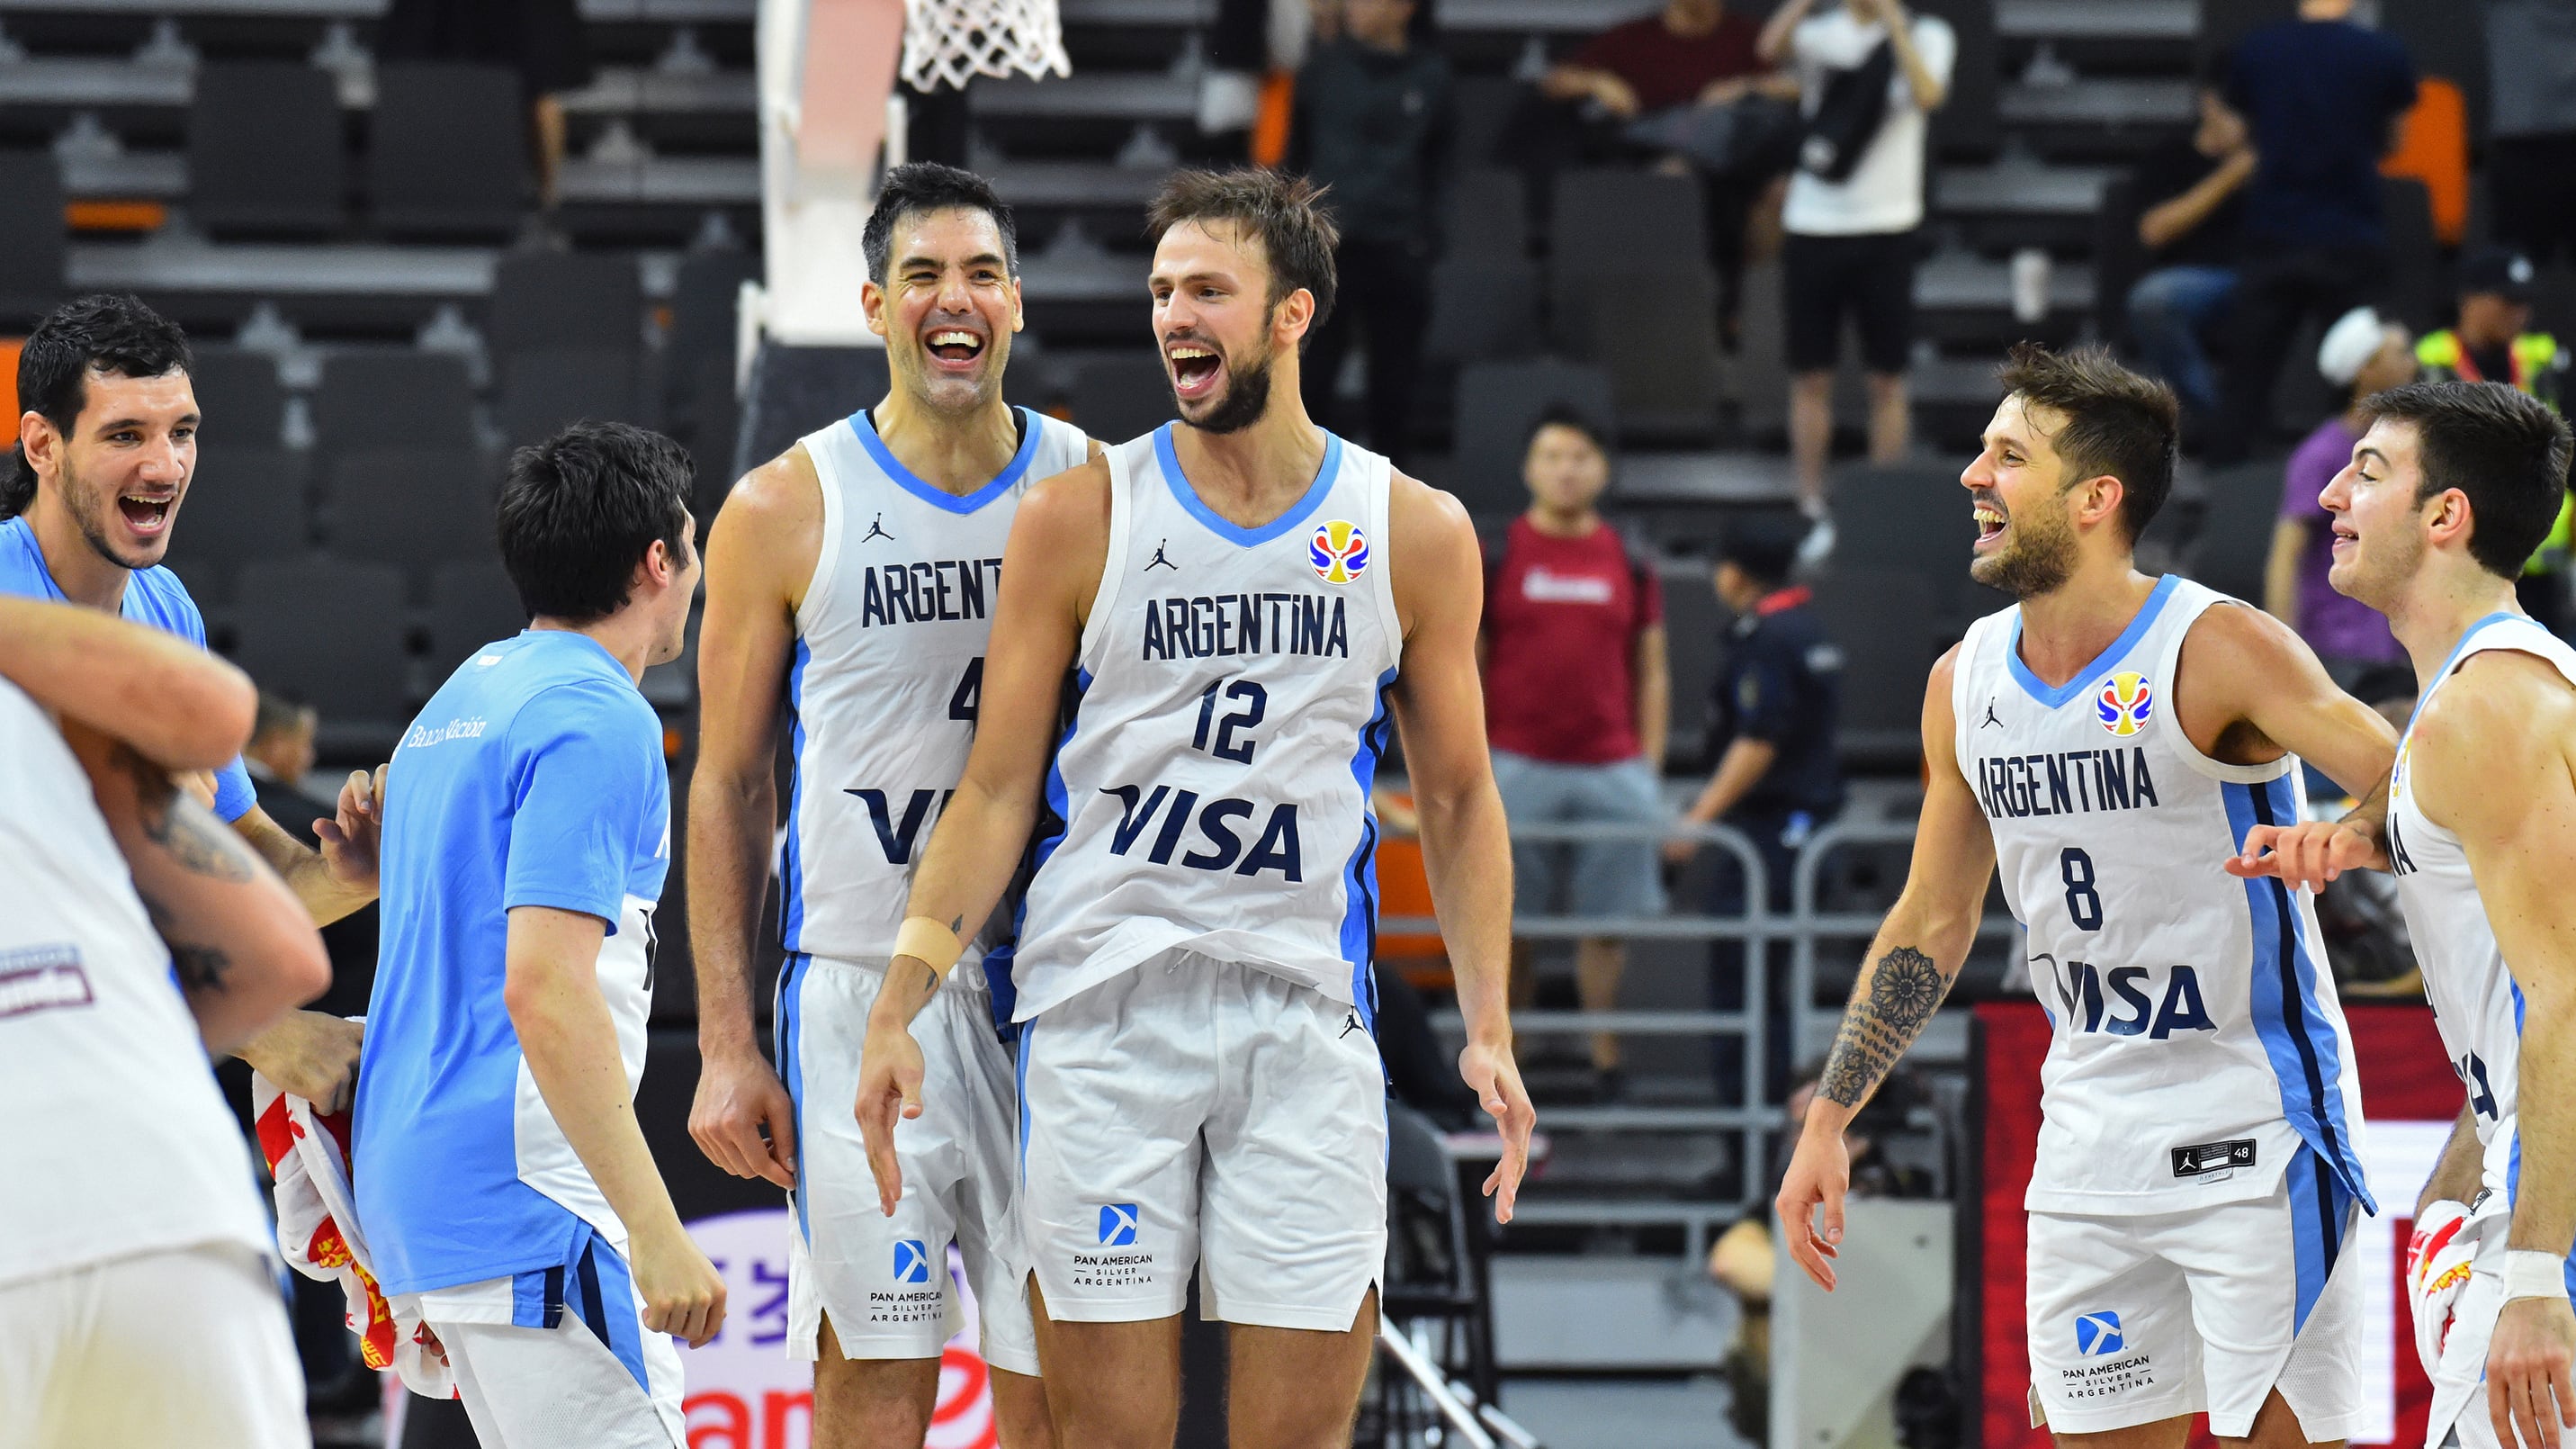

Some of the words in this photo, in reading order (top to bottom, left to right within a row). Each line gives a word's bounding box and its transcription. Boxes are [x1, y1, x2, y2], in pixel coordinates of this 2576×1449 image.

[862, 557, 1003, 628] ARGENT
[1143, 592, 1349, 661] ARGENTINA
[948, 656, 985, 739] 4
[1191, 679, 1268, 765] 12
[1979, 746, 2159, 818] ARGENTINA
[1099, 784, 1303, 883] VISA
[2060, 847, 2104, 932] 8
[2028, 952, 2219, 1040] VISA
[2233, 1146, 2250, 1159] 48
[1073, 1255, 1098, 1266] PAN
[1100, 1254, 1153, 1266] AMERICAN
[1095, 1267, 1137, 1276] SILVER
[1073, 1275, 1153, 1287] ARGENTINA
[869, 1292, 894, 1302] PAN
[891, 1303, 933, 1312] SILVER
[2062, 1368, 2086, 1380] PAN
[2087, 1354, 2150, 1377] AMERICAN
[2085, 1372, 2132, 1387] SILVER
[2068, 1376, 2155, 1400] ARGENTINA
